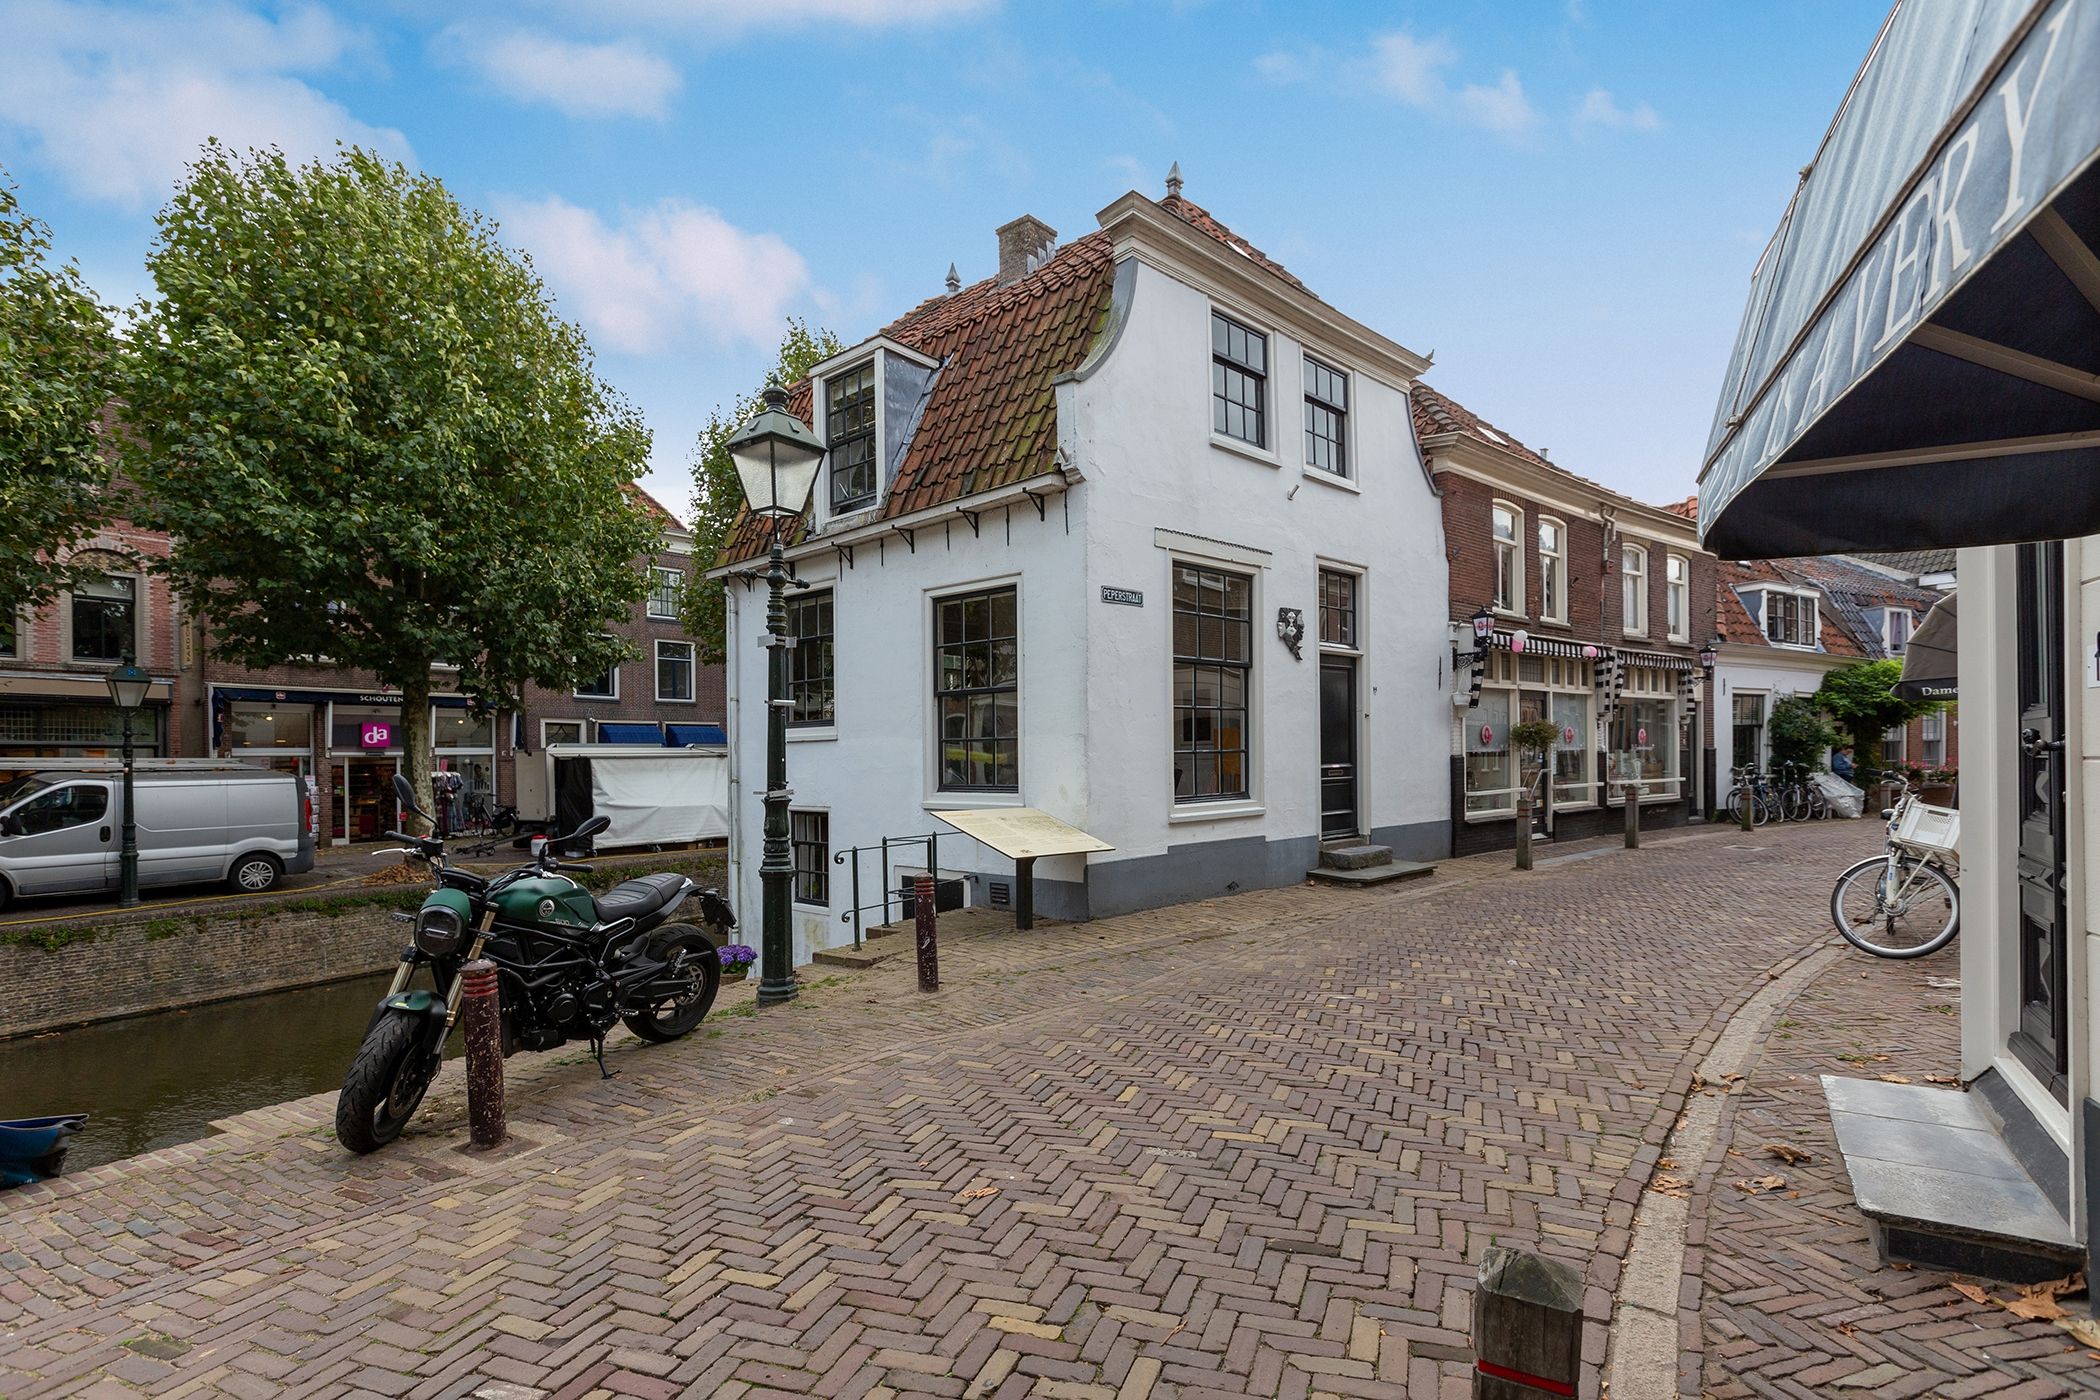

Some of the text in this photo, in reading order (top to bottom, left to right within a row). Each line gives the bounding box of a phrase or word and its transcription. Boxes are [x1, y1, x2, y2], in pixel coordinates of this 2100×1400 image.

[1850, 0, 2076, 378] VERY
[1103, 588, 1142, 604] PEPERSTRAAT
[364, 726, 388, 744] da
